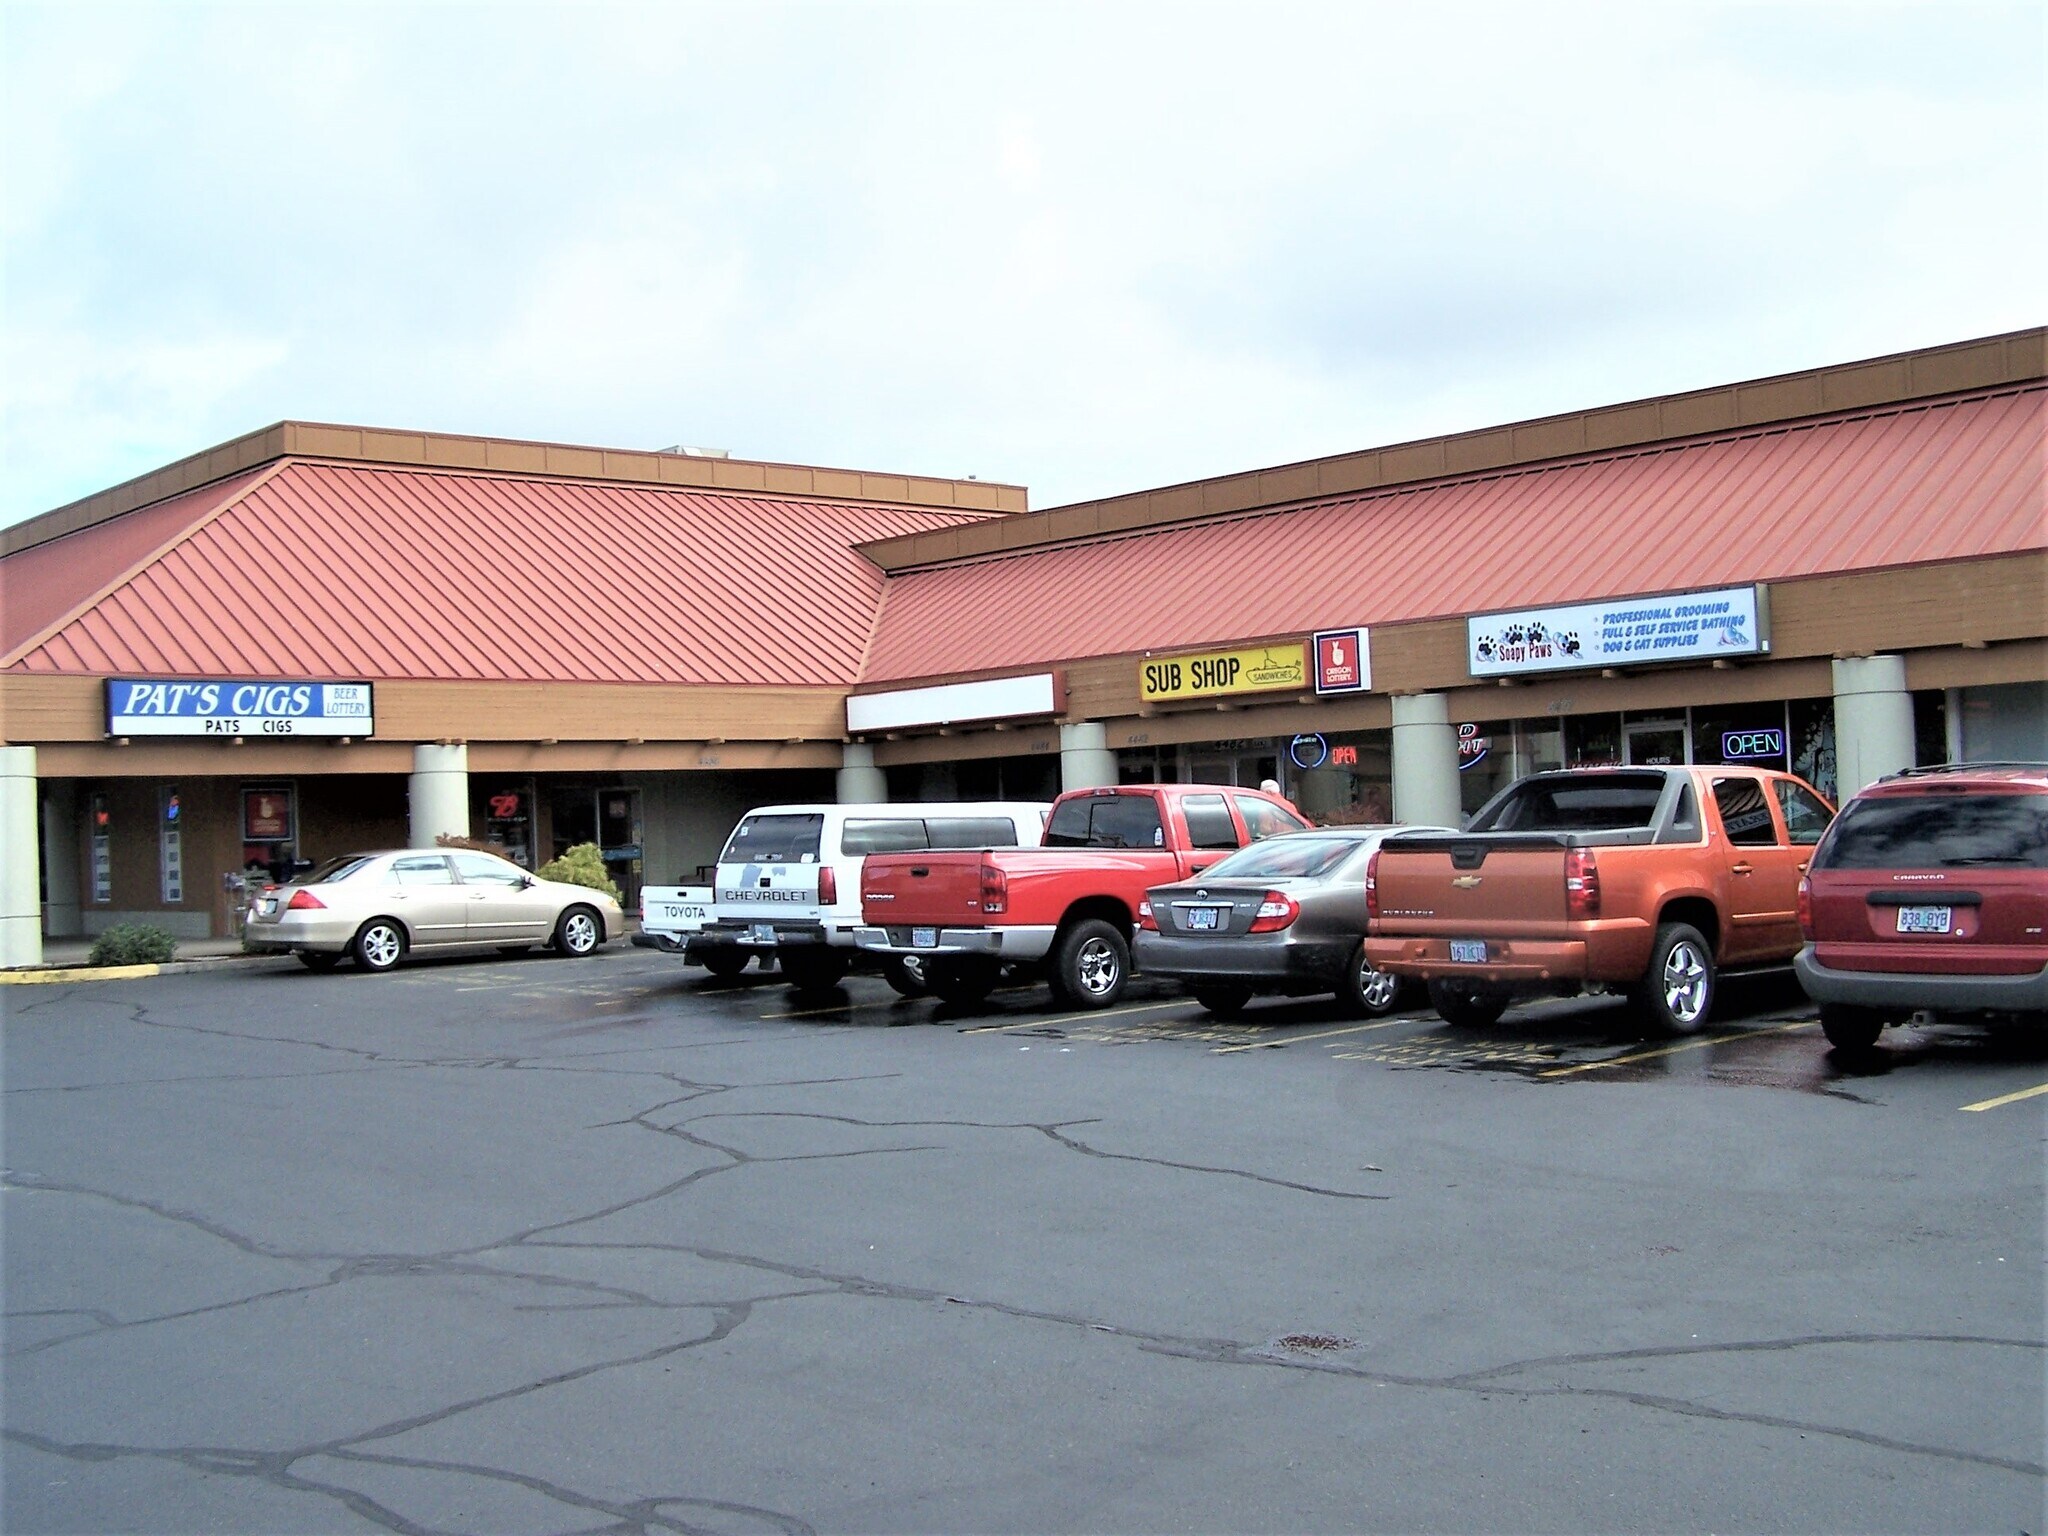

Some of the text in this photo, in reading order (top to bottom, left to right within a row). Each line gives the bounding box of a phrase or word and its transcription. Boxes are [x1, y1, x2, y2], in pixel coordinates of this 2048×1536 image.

[1603, 602, 1730, 625] PROFESSIONAL GROOMING
[1602, 615, 1745, 639] FULL & SELF SERVICE BATHING
[1499, 641, 1552, 662] Soapy Paws
[1603, 634, 1699, 653] DOG & CAT SUPPLIES
[1146, 657, 1240, 694] SUB SHOP
[1253, 669, 1293, 682] SANDWICHES
[123, 684, 311, 716] PAT'S CIGS
[334, 688, 358, 700] BEER
[327, 702, 365, 714] LOTTERY
[206, 720, 292, 733] PATS CIGS
[1727, 733, 1779, 755] OPEN
[1332, 746, 1357, 765] OPEN
[725, 891, 807, 901] CHEVROLET
[664, 906, 706, 918] TOYOTA
[1901, 912, 1920, 926] 838
